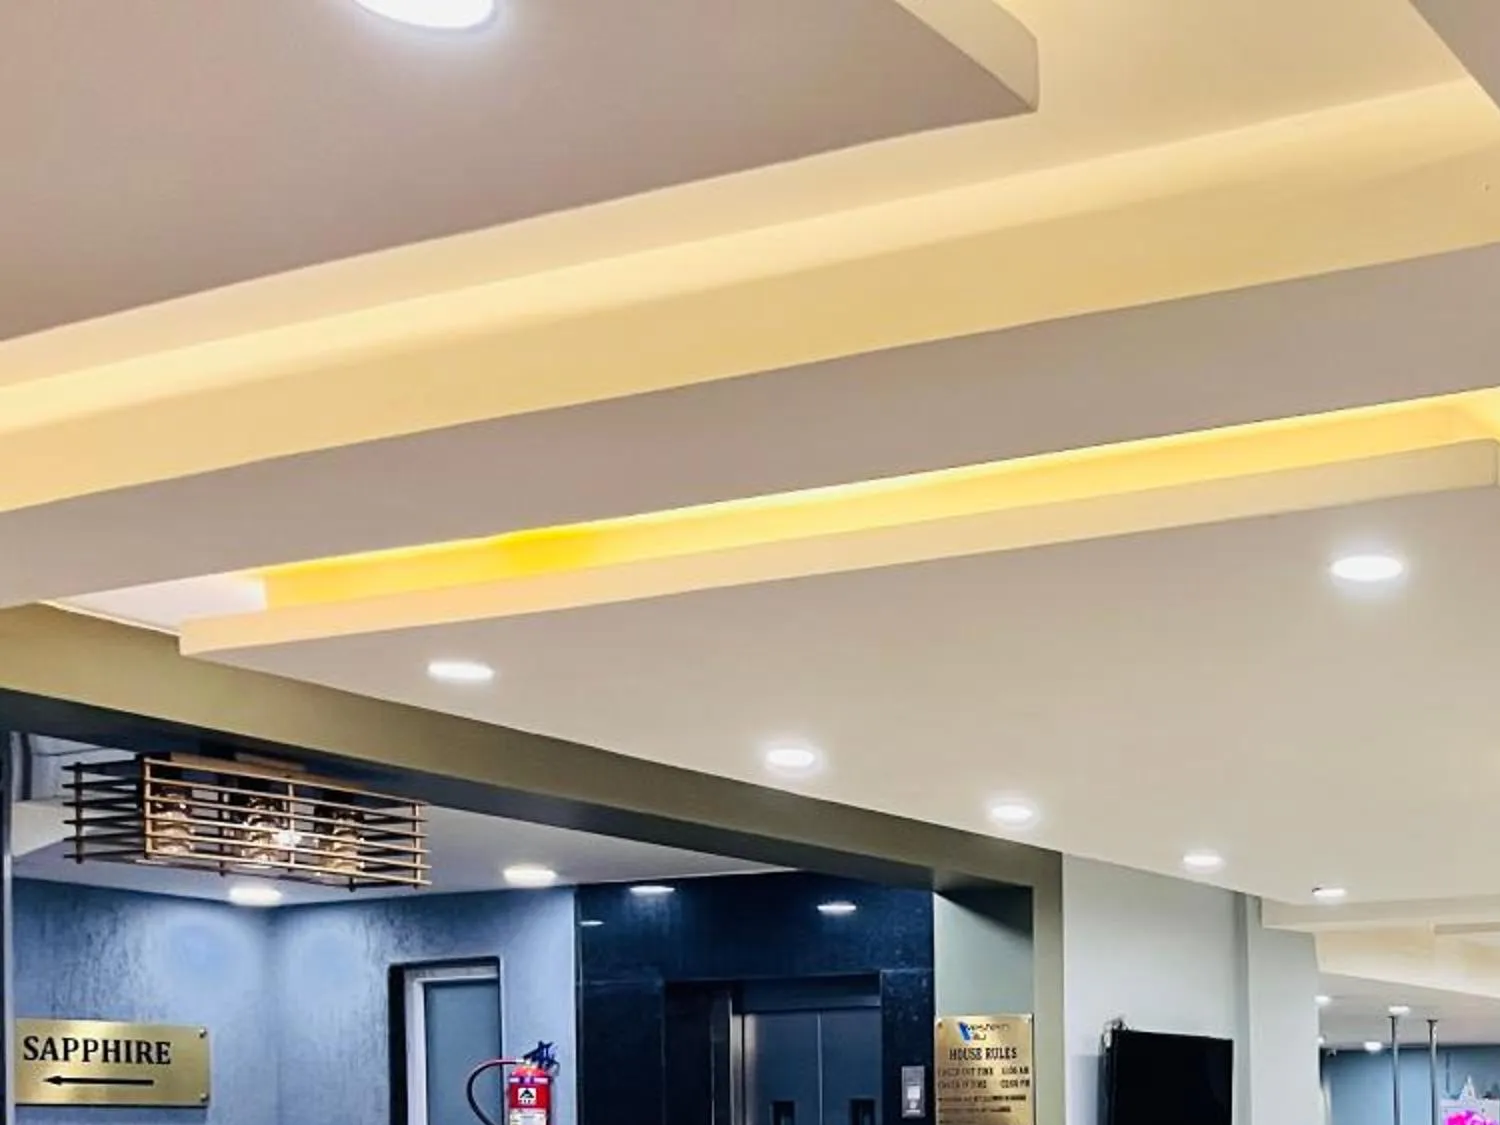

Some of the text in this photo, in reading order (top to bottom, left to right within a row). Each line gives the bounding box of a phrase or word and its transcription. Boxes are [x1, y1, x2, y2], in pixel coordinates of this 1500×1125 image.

[23, 1035, 171, 1064] SAPPHIRE
[949, 1047, 1017, 1061] HOUSE RULES
